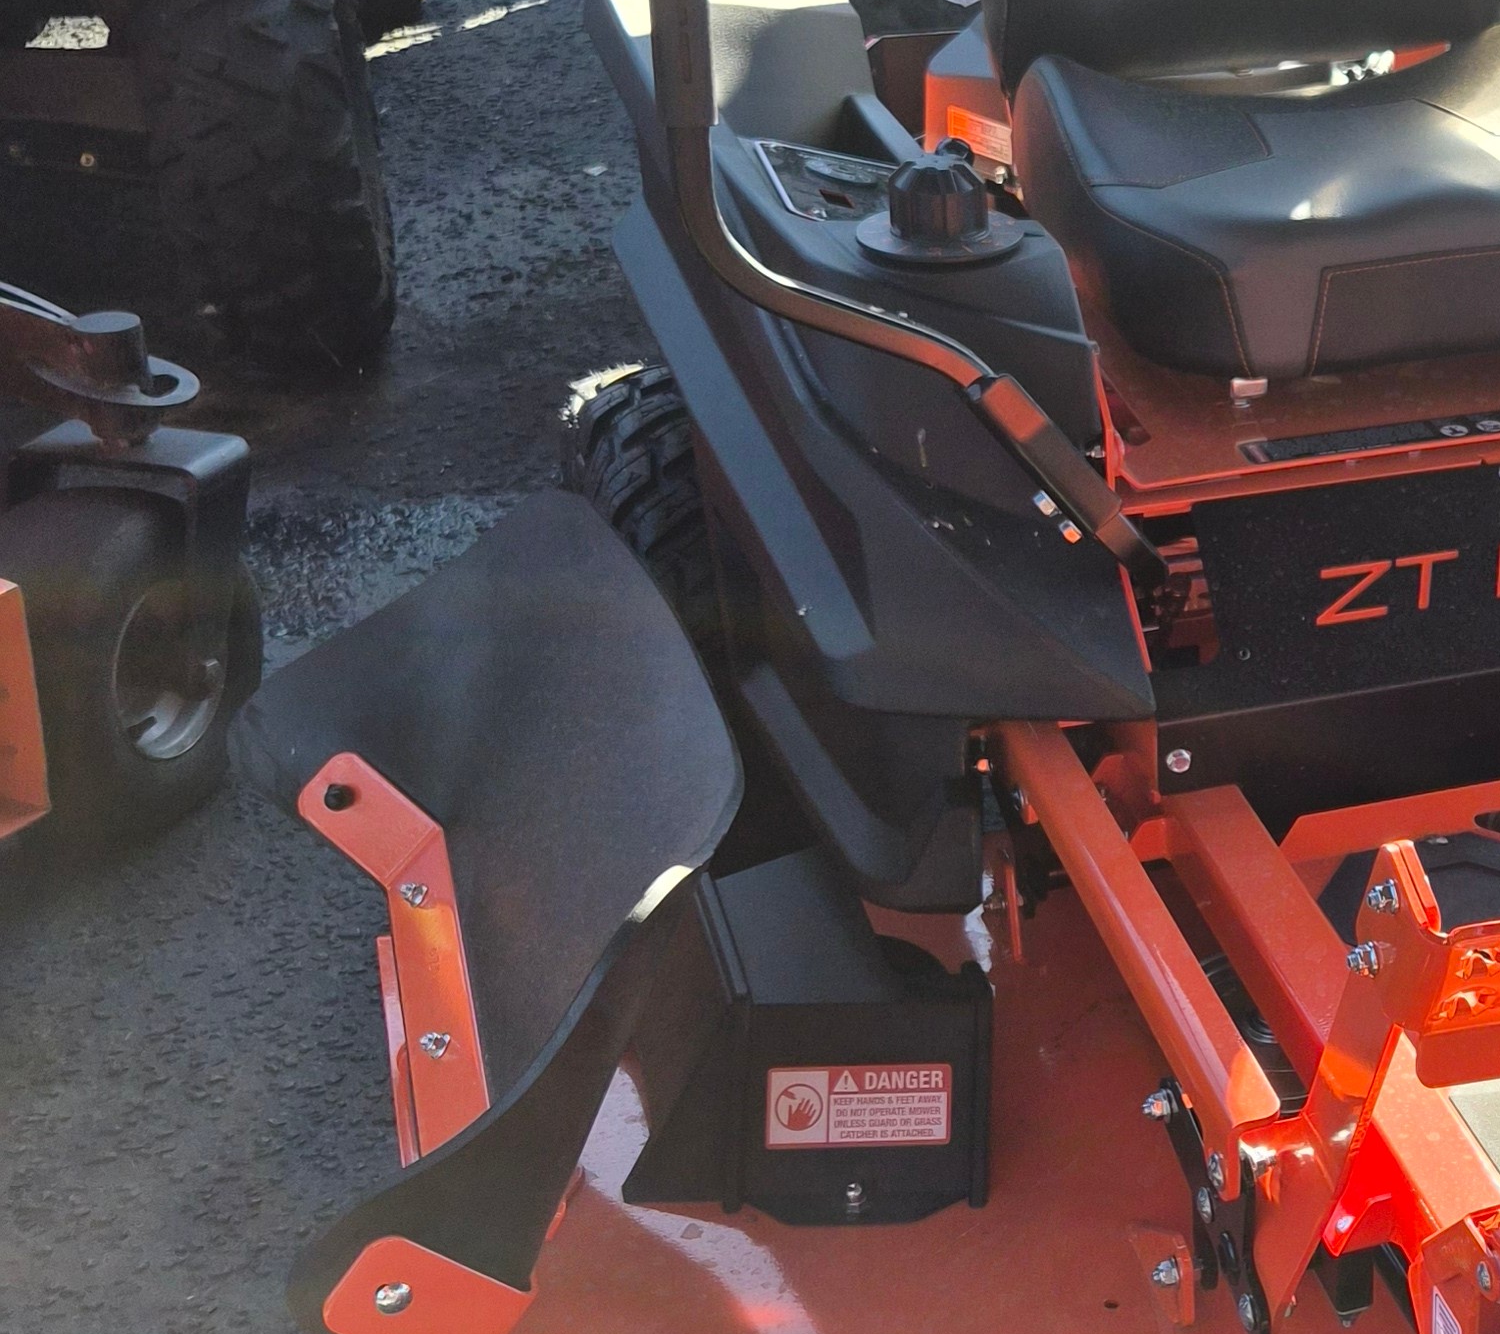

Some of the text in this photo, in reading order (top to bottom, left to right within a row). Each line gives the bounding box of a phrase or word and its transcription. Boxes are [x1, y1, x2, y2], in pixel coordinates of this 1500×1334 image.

[1315, 549, 1460, 626] ZT
[864, 1070, 944, 1090] DANGER
[833, 1097, 855, 1106] KEEP
[856, 1096, 885, 1105] HANDS
[896, 1095, 915, 1104] FEET
[835, 1106, 941, 1117] DO NOT OPERATE MOWER
[833, 1117, 942, 1128] UNLESS GUARD OR GRASS
[840, 1129, 878, 1139] CATCHER
[880, 1129, 889, 1138] IS
